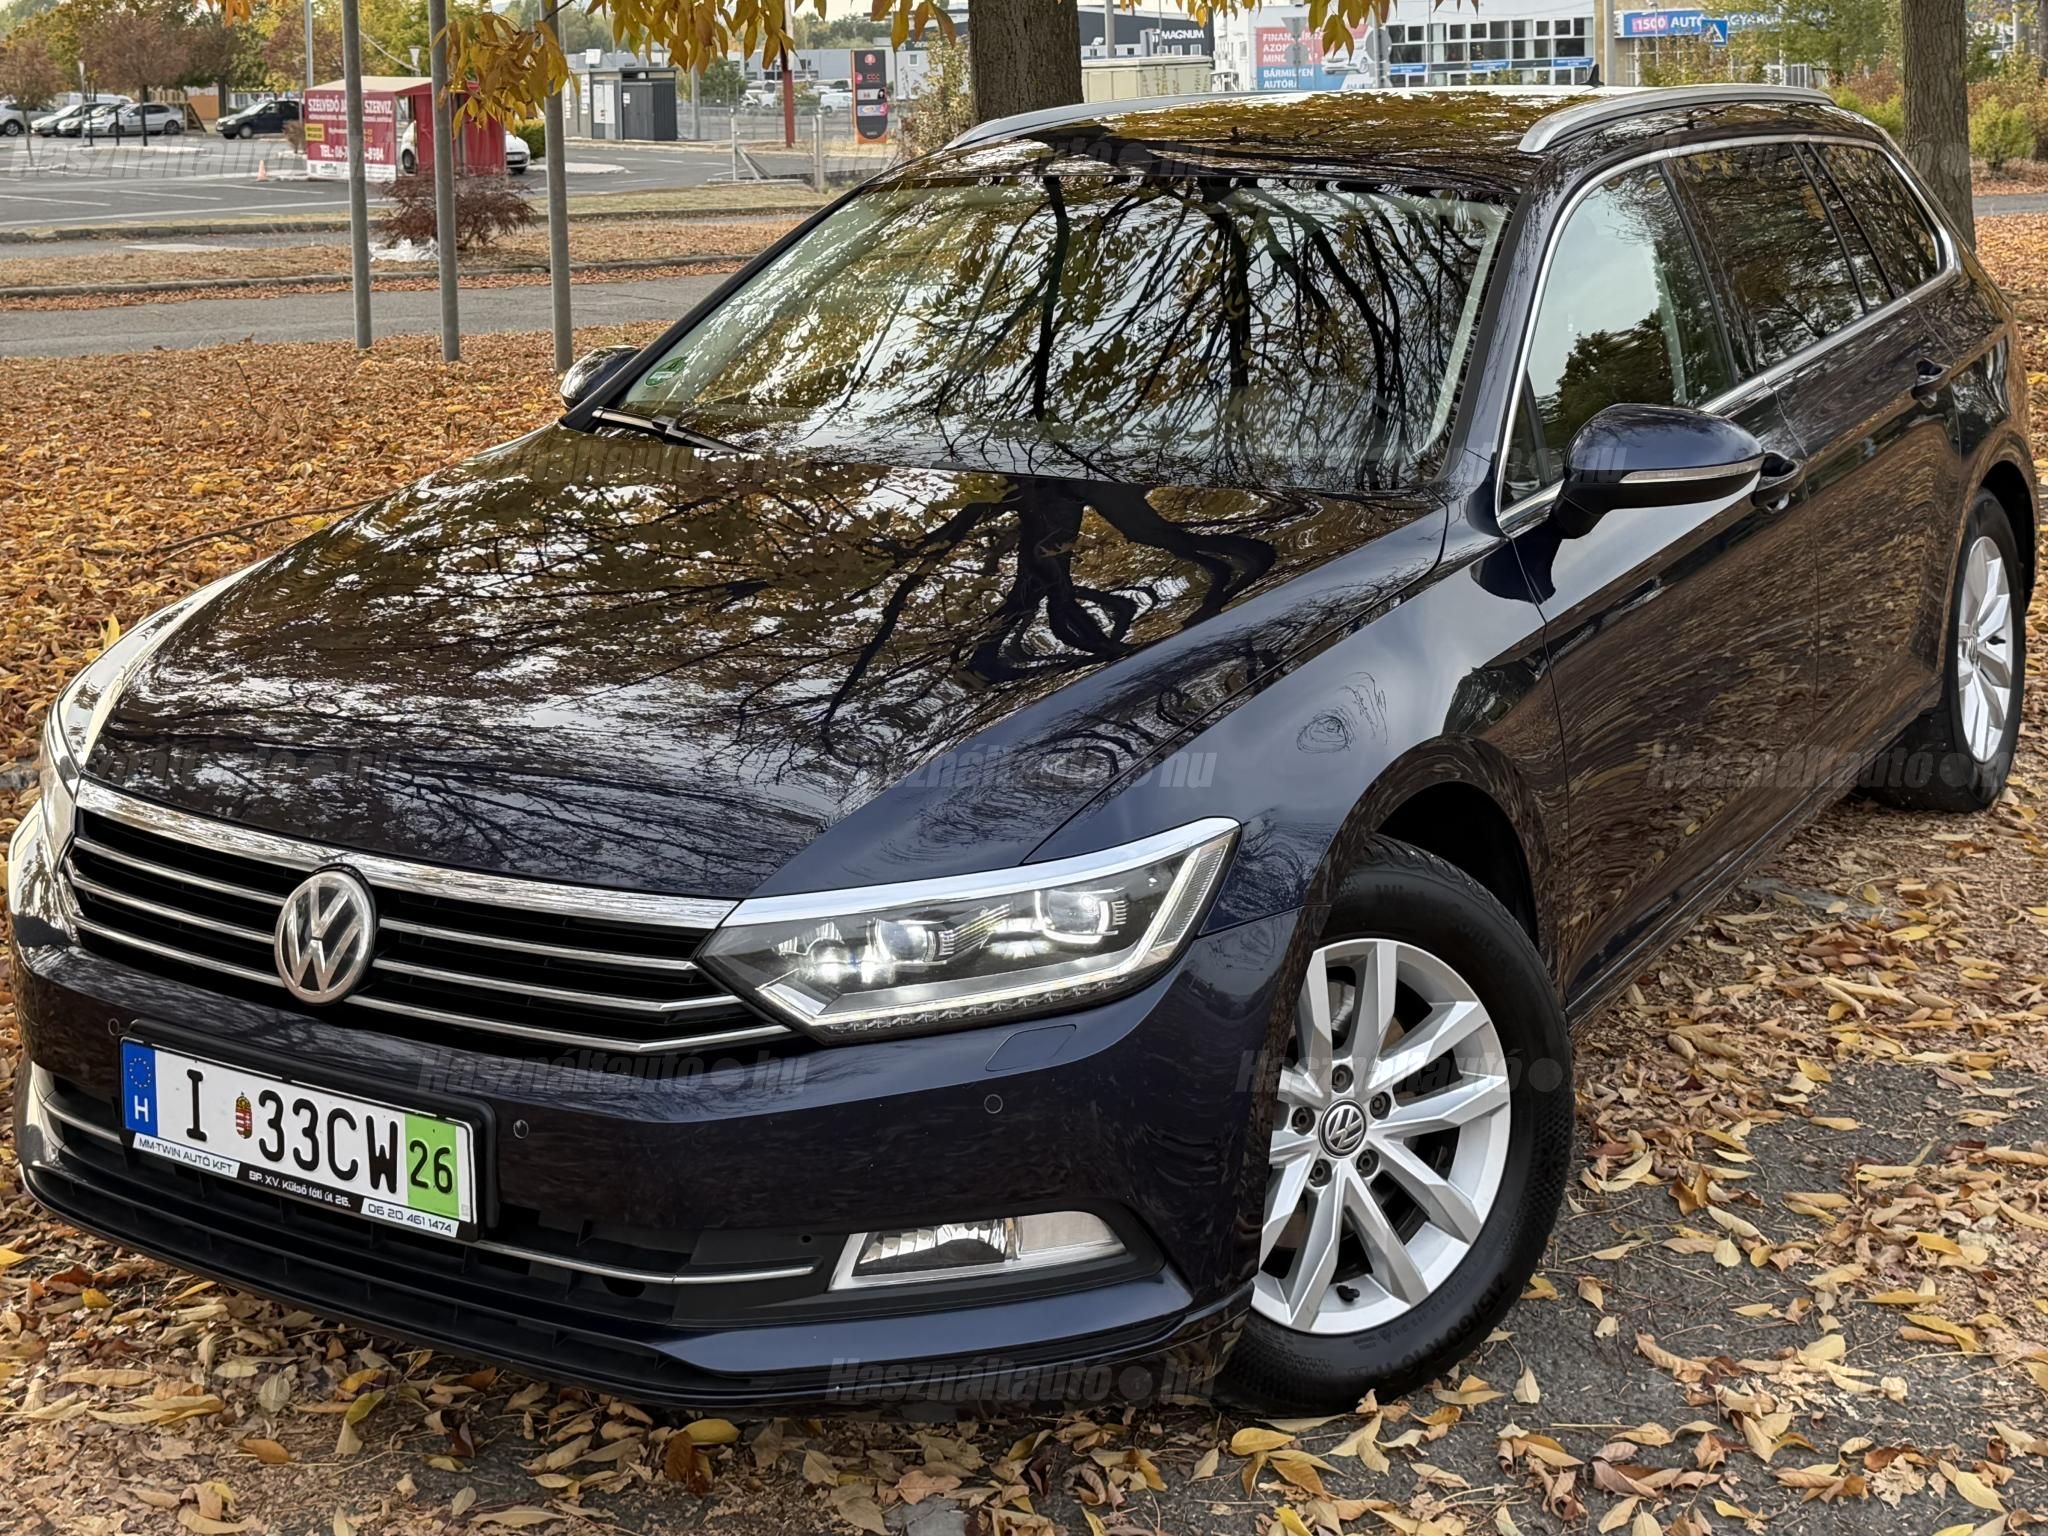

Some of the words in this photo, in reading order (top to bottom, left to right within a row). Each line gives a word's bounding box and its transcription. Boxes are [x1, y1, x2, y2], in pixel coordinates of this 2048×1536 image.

[1161, 29, 1204, 40] MAGNUM
[1637, 16, 1666, 31] 1500
[364, 100, 393, 114] SZERVIZ
[134, 1095, 150, 1123] H
[139, 1137, 181, 1158] MM-TWIN
[258, 1089, 399, 1195] 33CW
[409, 1139, 454, 1195] 26
[265, 1175, 281, 1188] XV.
[335, 1195, 352, 1208] 26.
[368, 1203, 385, 1216] 06
[388, 1208, 404, 1221] 20
[406, 1213, 426, 1226] 461
[428, 1218, 453, 1233] 1474
